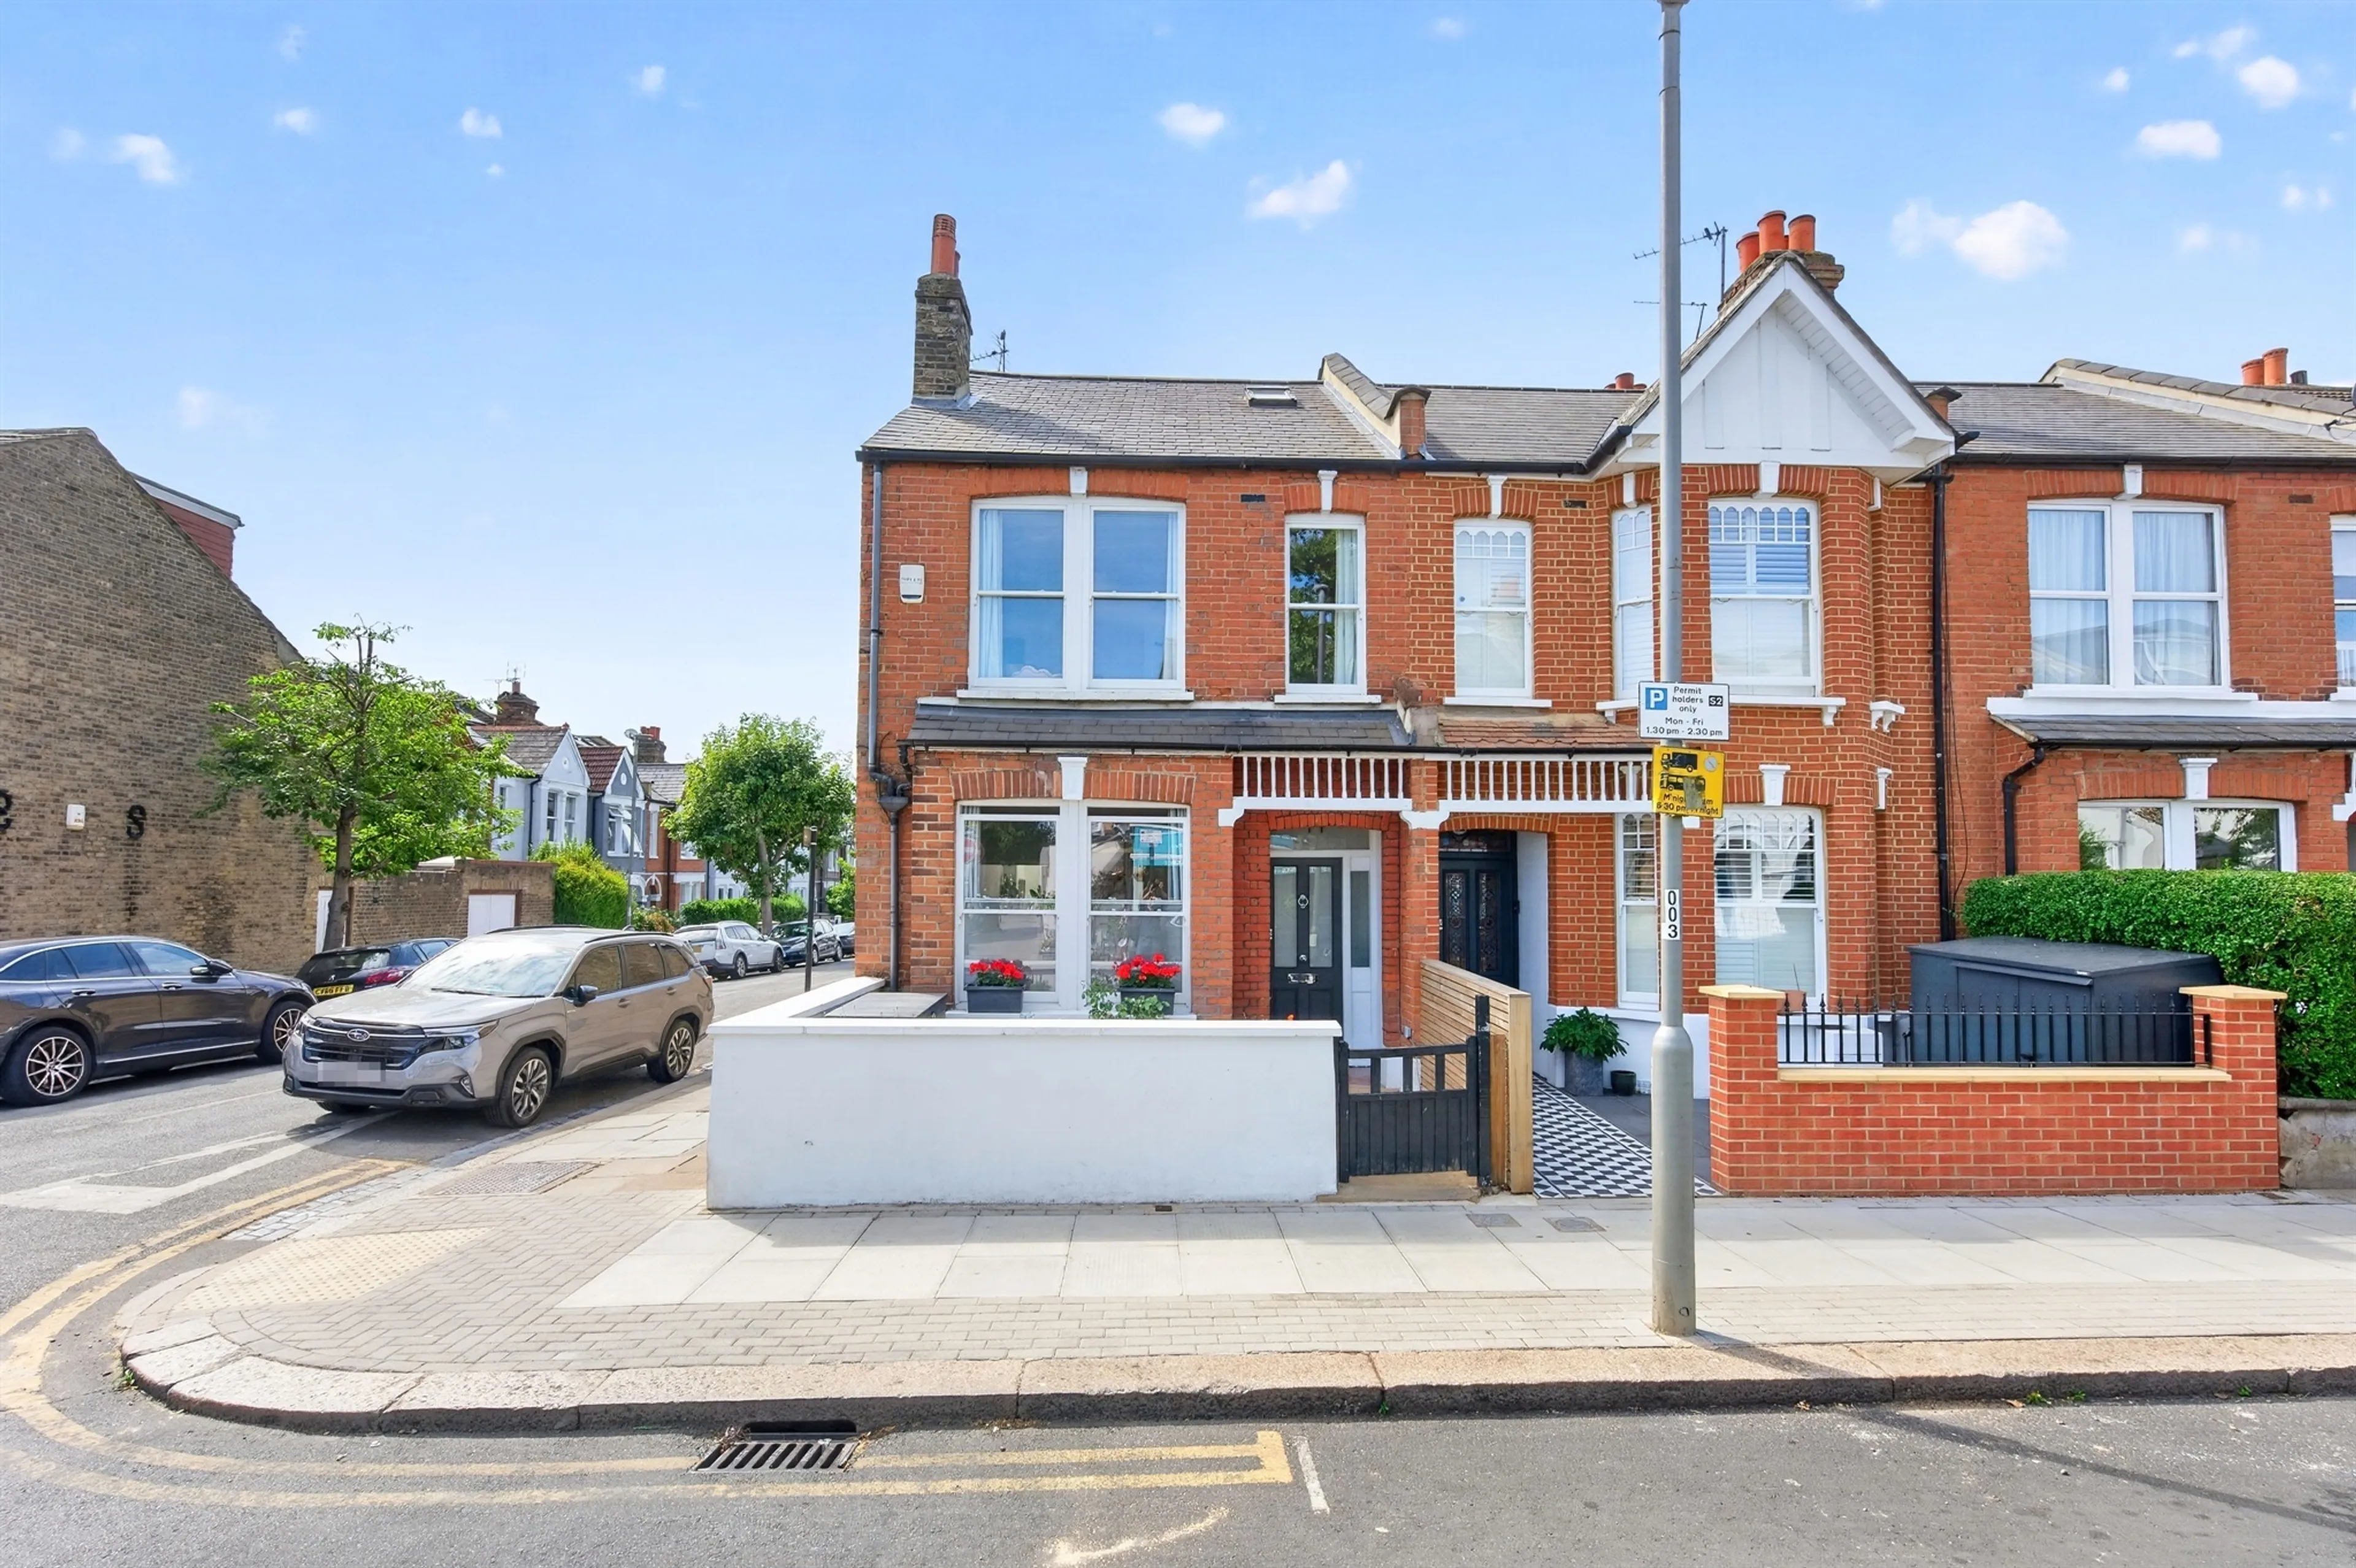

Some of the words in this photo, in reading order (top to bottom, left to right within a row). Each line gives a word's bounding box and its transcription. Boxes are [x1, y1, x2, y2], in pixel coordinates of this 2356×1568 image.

[1650, 690, 1664, 708] P
[1664, 794, 1684, 802] M'nig
[1668, 890, 1678, 938] 003
